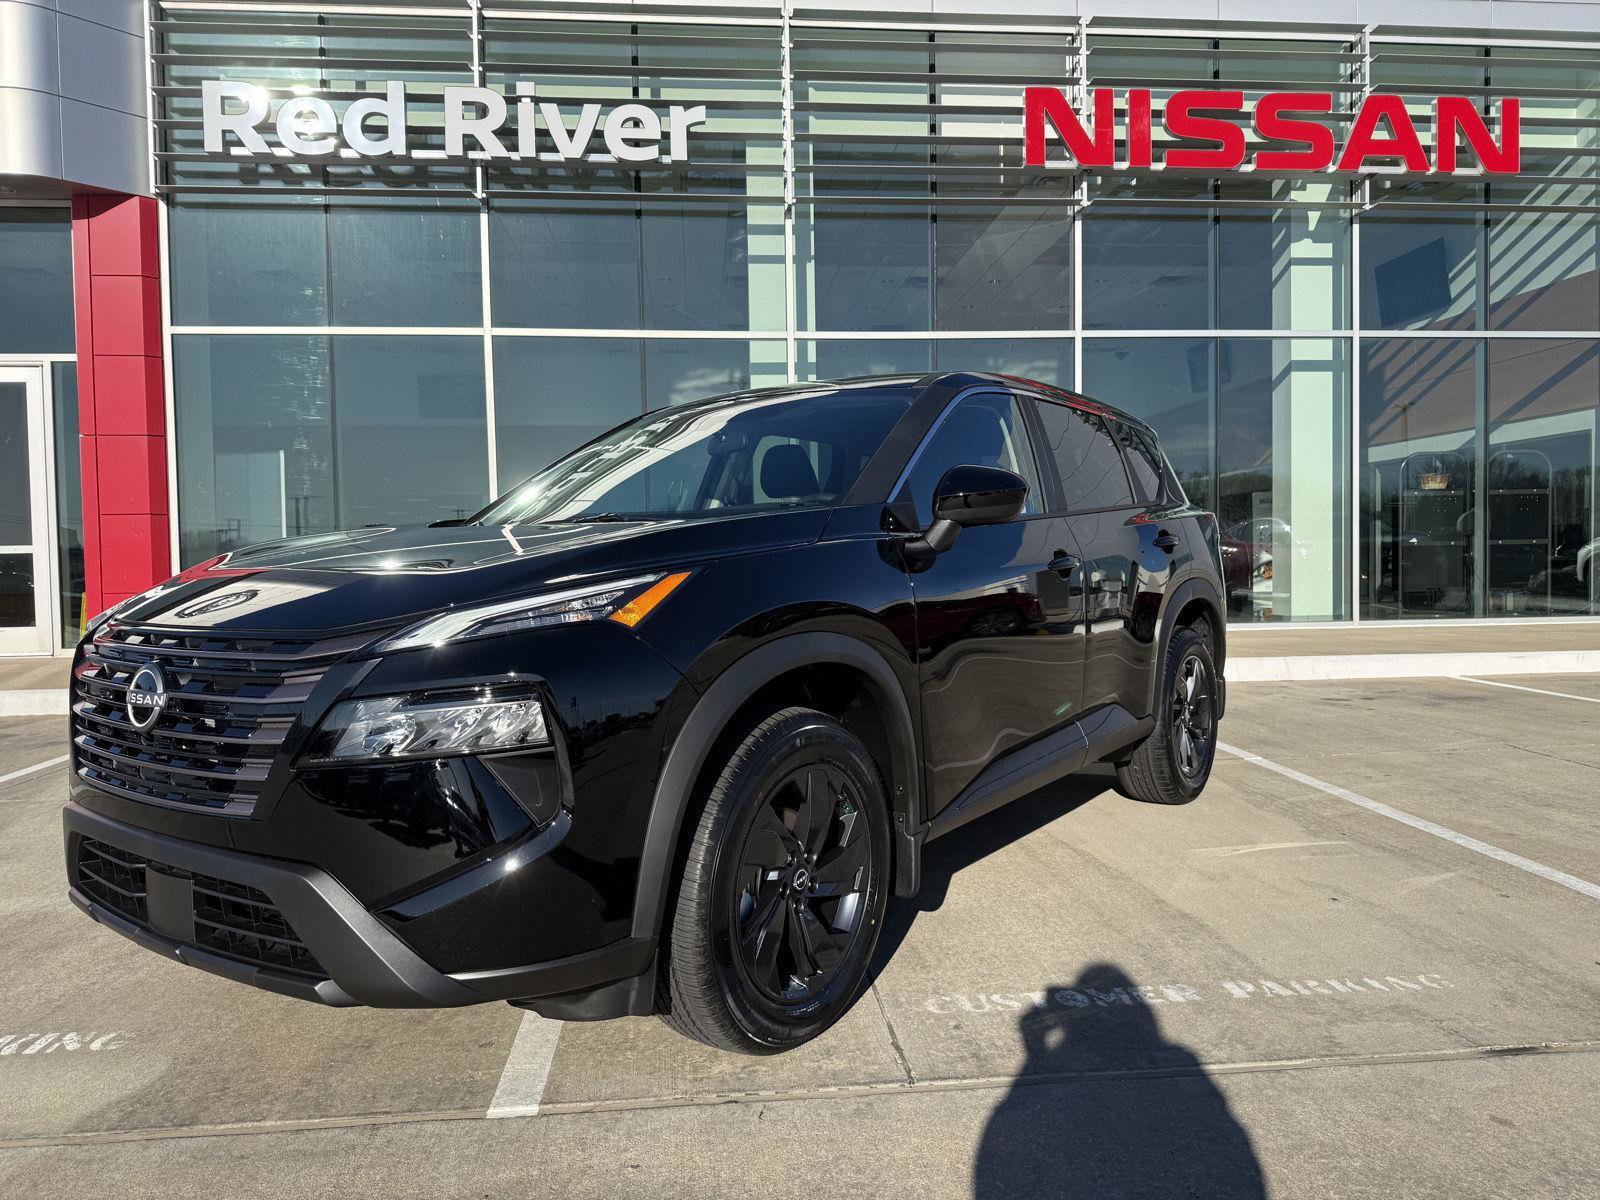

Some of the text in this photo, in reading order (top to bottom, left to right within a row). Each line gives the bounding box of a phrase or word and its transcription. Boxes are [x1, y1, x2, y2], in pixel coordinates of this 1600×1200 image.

[201, 80, 707, 162] Red River
[1023, 86, 1521, 174] NISSAN
[128, 692, 164, 706] SSAN
[1222, 974, 1454, 998] PARKING
